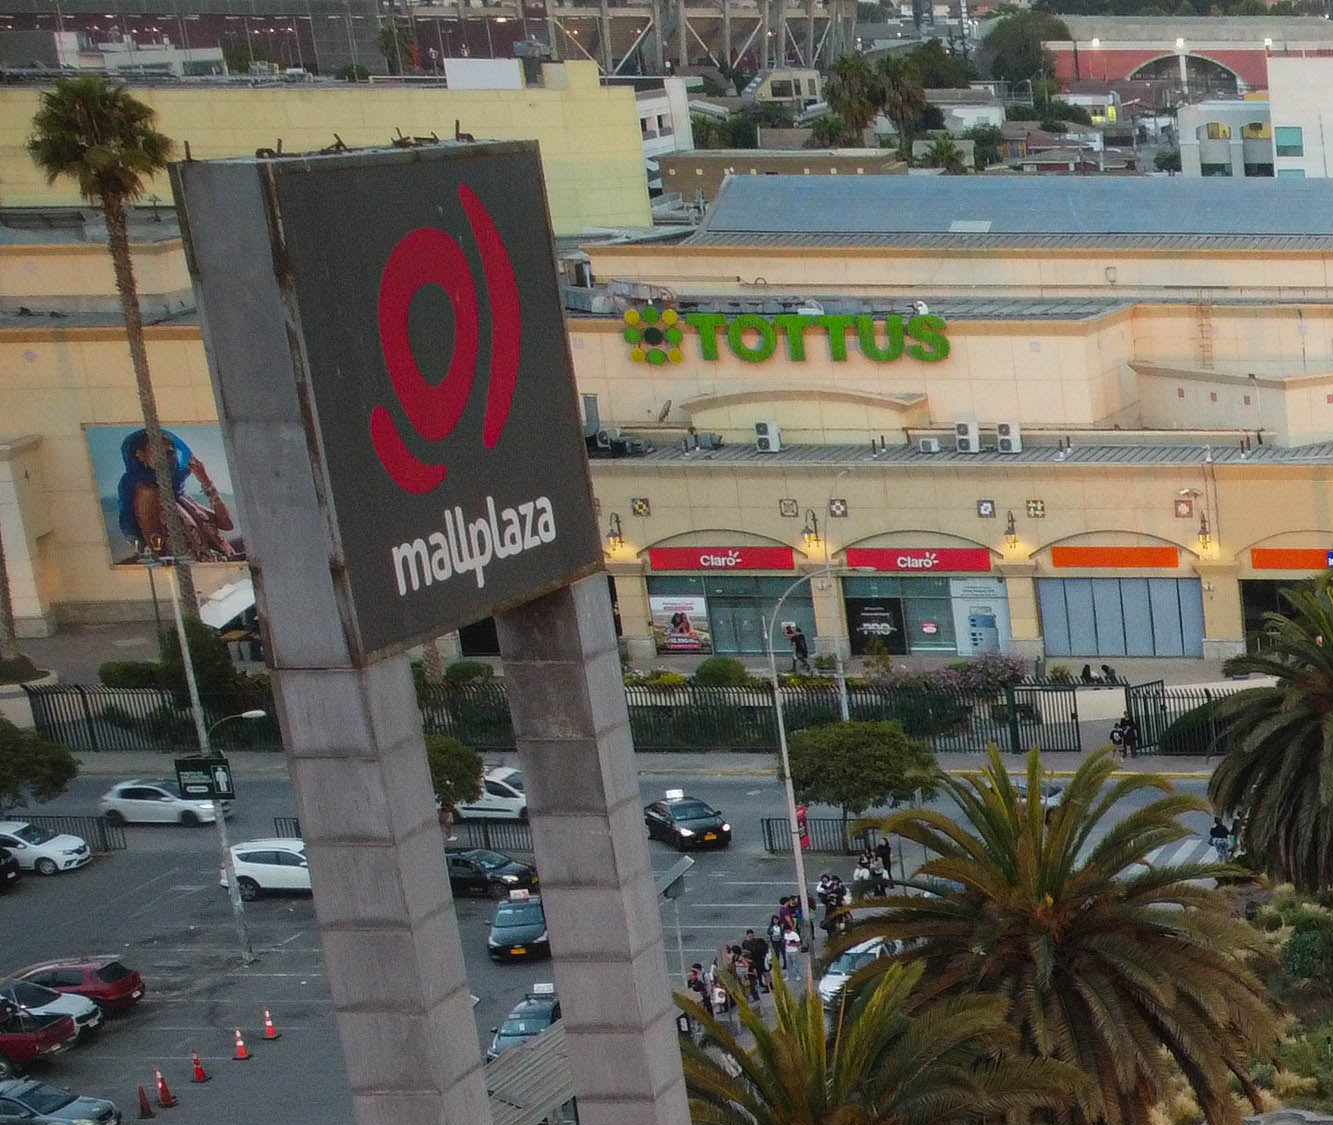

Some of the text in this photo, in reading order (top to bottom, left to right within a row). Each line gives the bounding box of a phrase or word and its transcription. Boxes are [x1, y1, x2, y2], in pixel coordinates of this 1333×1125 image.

[684, 312, 951, 364] TOTTUS
[392, 496, 556, 596] mallplaza
[700, 554, 737, 567] Claro
[897, 555, 933, 568] Claro
